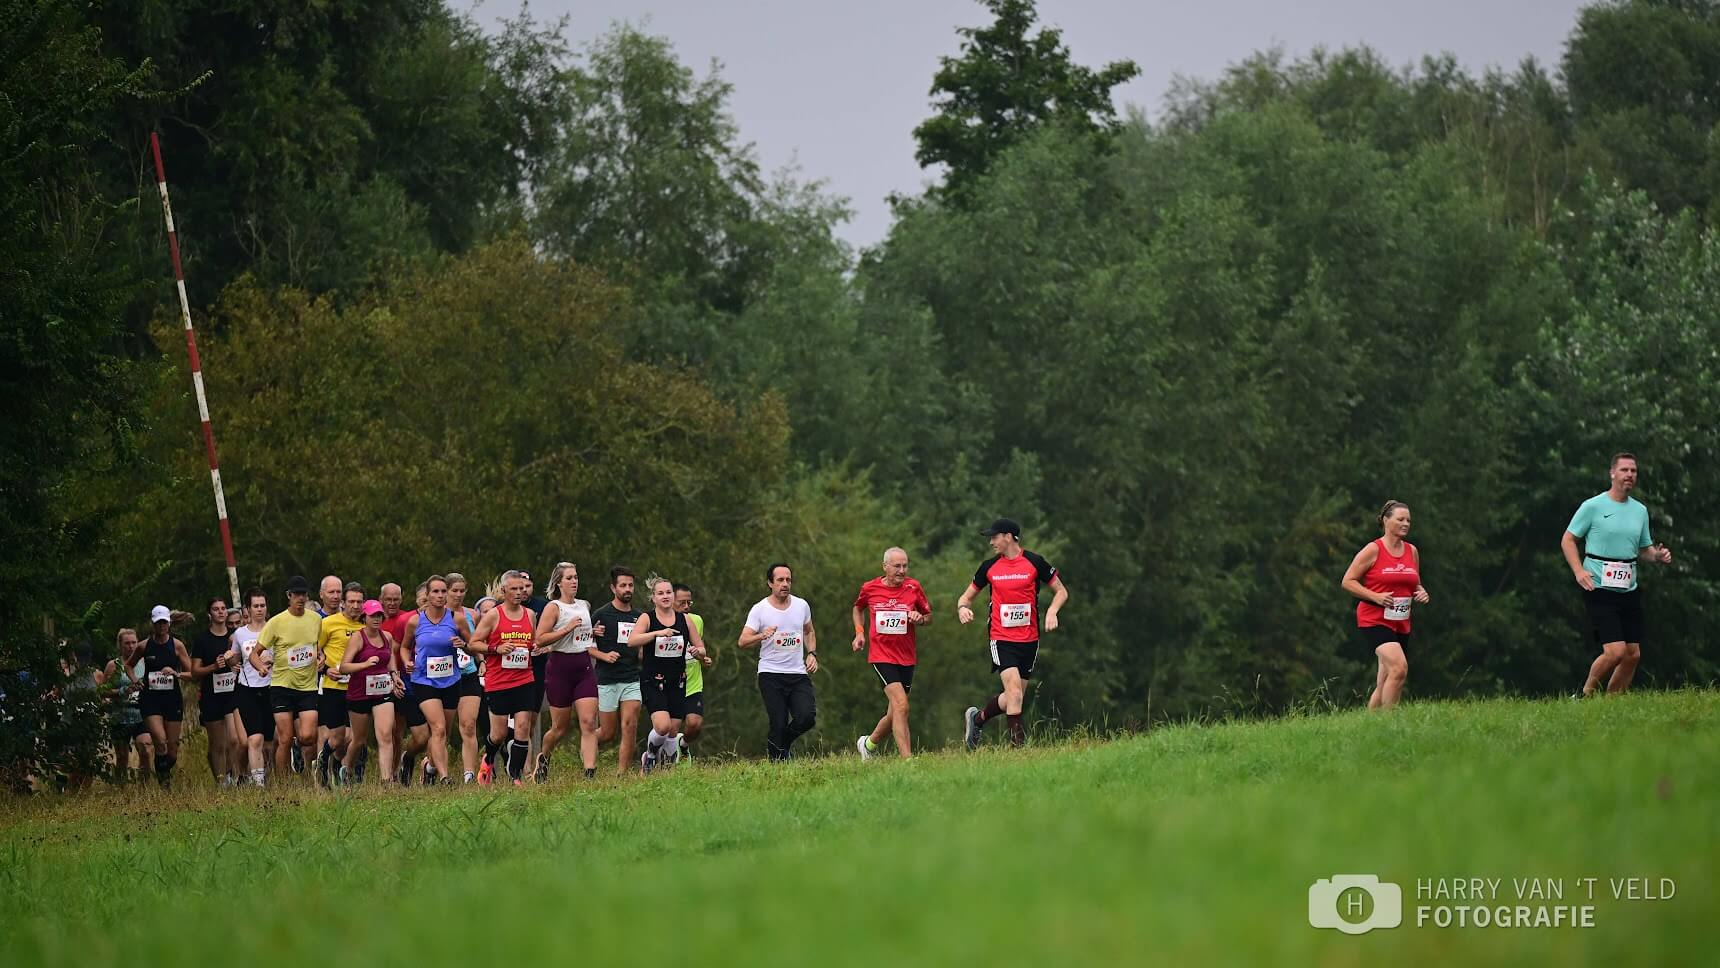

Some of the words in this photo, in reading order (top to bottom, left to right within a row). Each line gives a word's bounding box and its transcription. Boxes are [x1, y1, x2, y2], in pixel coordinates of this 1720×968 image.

[1613, 571, 1628, 580] 157
[1010, 611, 1024, 620] 155
[886, 618, 900, 628] 137
[782, 637, 796, 647] 206
[664, 643, 678, 651] 122
[296, 652, 309, 662] 124
[435, 663, 448, 672] 203
